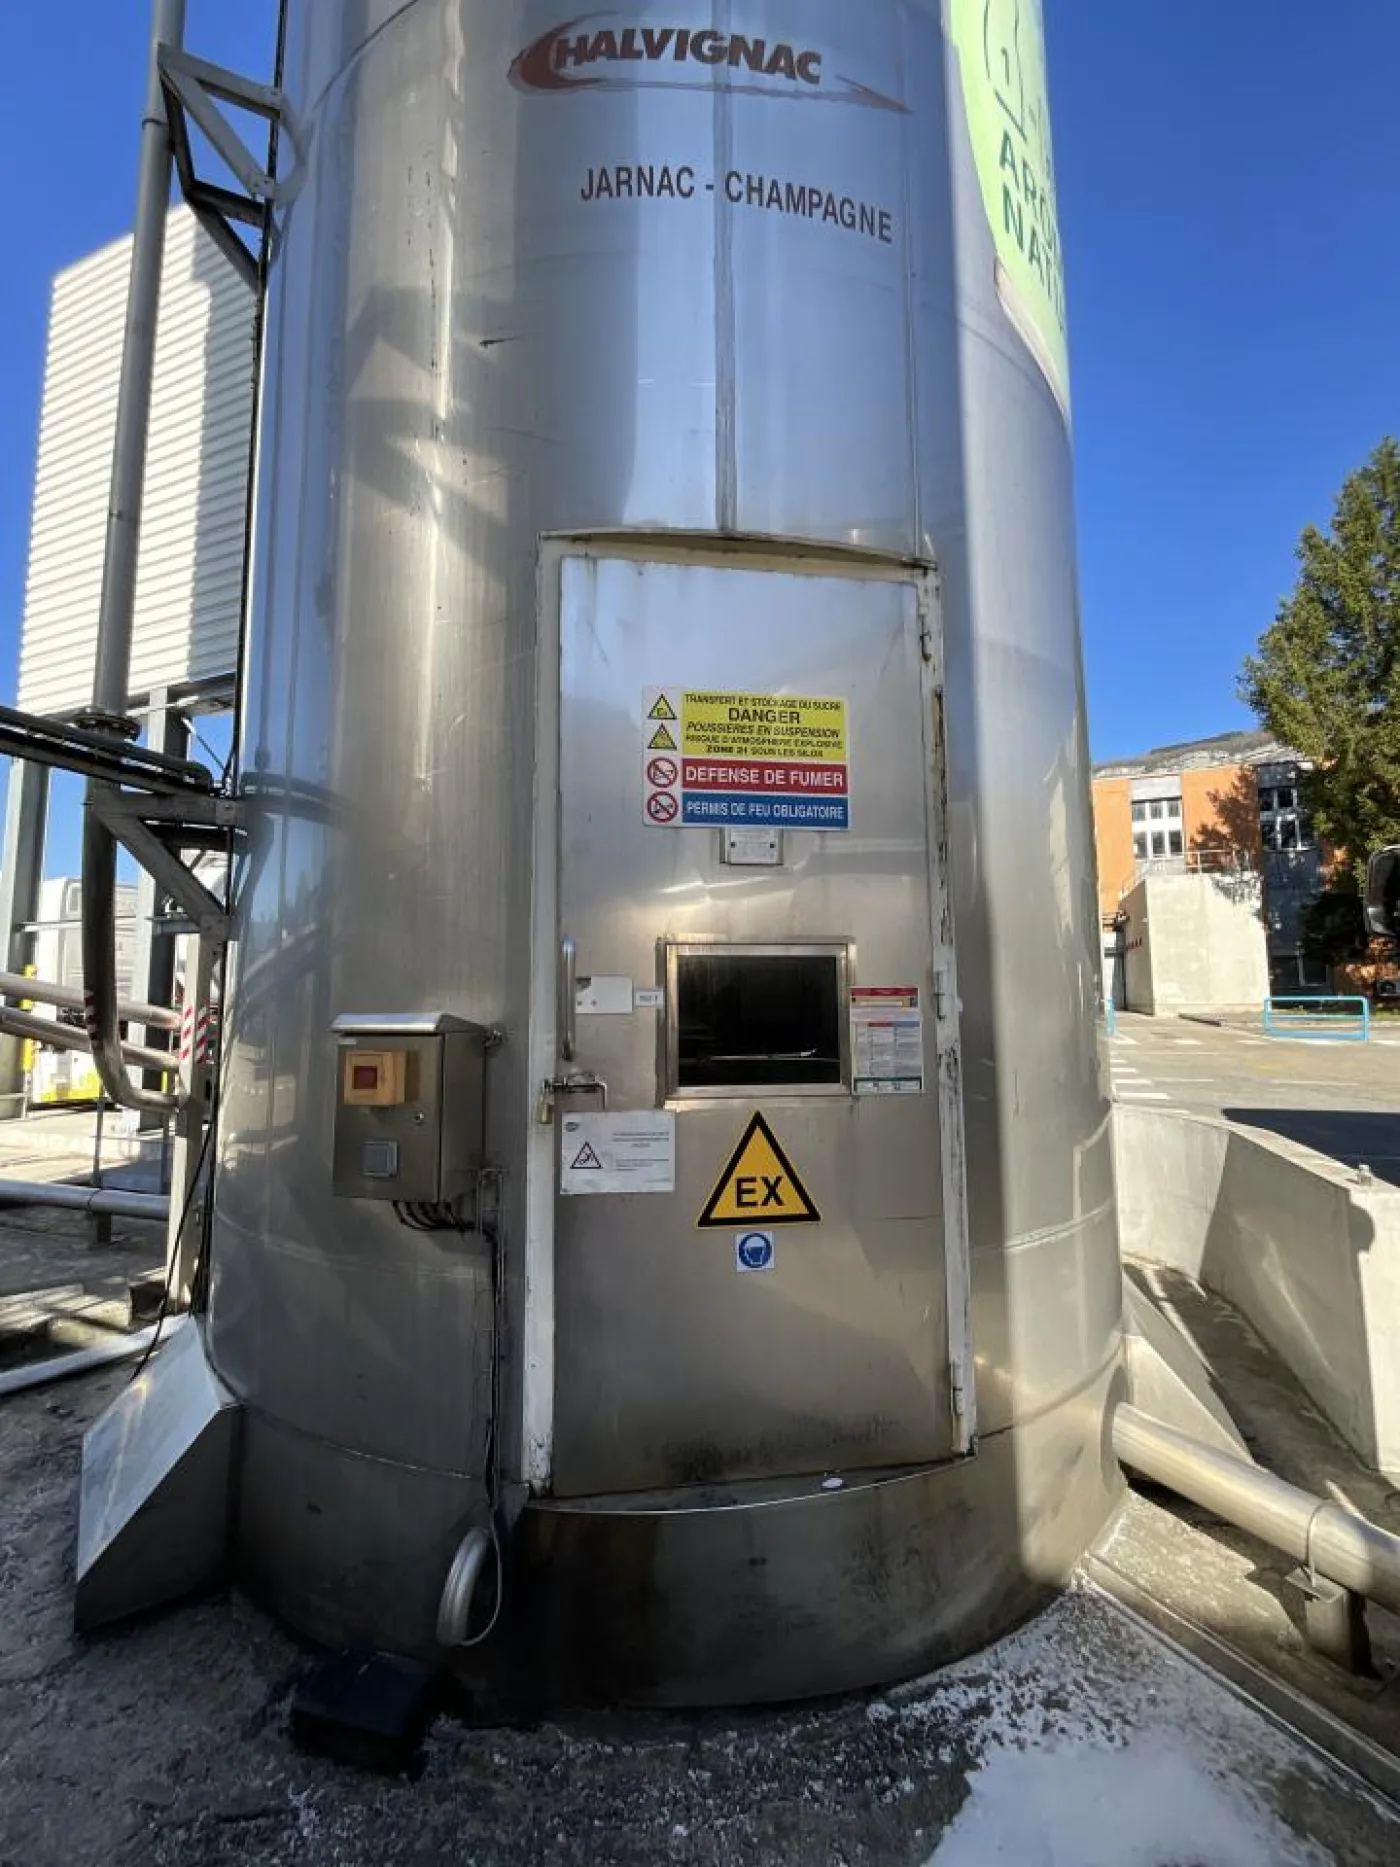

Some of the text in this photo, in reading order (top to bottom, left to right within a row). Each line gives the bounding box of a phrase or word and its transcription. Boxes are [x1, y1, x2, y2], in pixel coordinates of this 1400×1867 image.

[580, 165, 696, 200] JARNAC
[724, 170, 892, 244] CHAMPAGNE
[684, 694, 841, 711] TRANSFERT ET STOCKAGE DU SUCRE
[728, 707, 800, 724] DANGER
[686, 721, 841, 738] POUSSIERES EN SUSPENSION
[685, 734, 720, 744] RISQUE
[706, 745, 734, 754] ZONE
[750, 747, 776, 756] SOUS
[777, 748, 796, 757] LES
[797, 749, 824, 758] SILOS
[685, 765, 843, 788] DEFENSE DE FUMER
[686, 800, 845, 819] PERMIS DE FEU OBLIGATOIRE
[736, 1176, 786, 1208] EX
